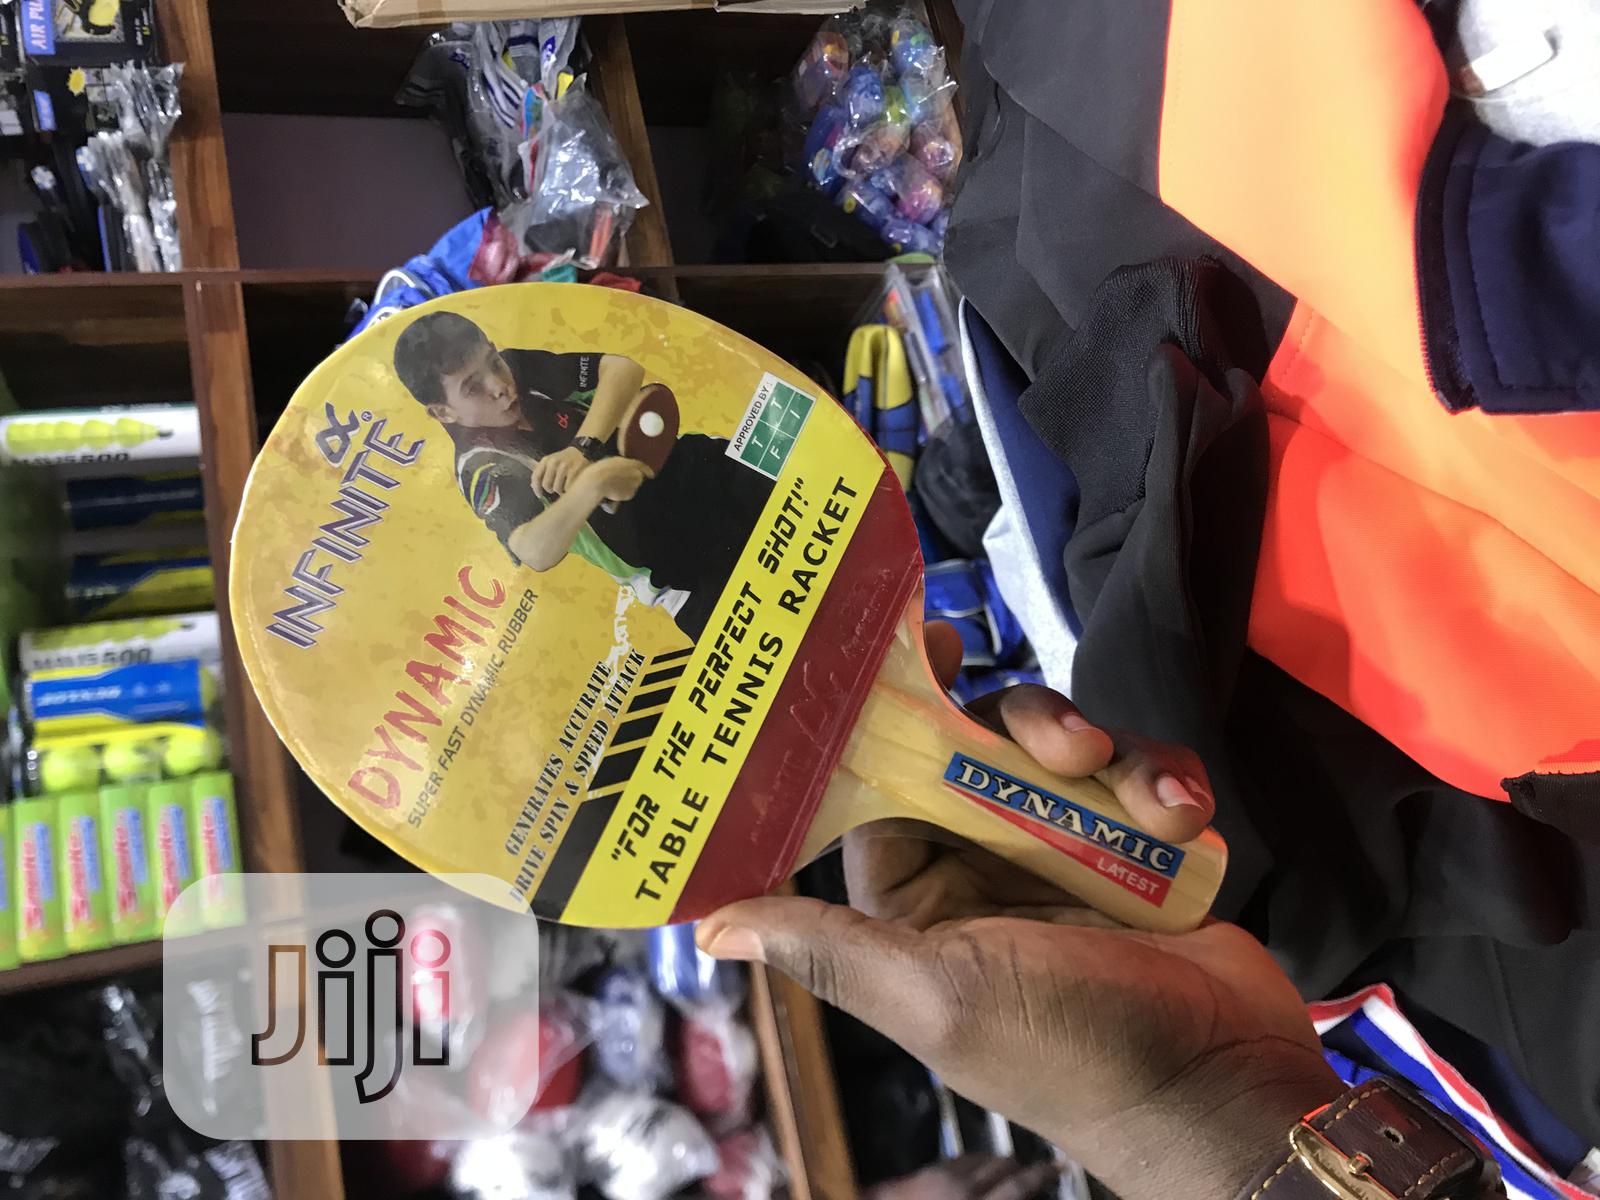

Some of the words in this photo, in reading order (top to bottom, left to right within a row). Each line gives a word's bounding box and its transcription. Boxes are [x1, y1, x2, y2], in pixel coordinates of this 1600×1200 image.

[29, 0, 46, 21] PU
[30, 23, 48, 49] AIR
[734, 401, 763, 452] APPROVED
[265, 418, 426, 649] INFINITE
[347, 565, 507, 809] DYNAMIC
[407, 771, 444, 828] SUPER
[438, 726, 467, 771] FAST
[460, 654, 505, 727] DYNAMIC
[497, 588, 538, 656] RUBBER
[504, 753, 564, 857] GENERATES
[558, 660, 612, 753] ACCURATE
[509, 845, 546, 904] DRIVE
[539, 797, 570, 844] SPIN
[564, 779, 580, 797] &
[573, 719, 610, 778] SPEED
[603, 649, 648, 719] ATTACK
[634, 787, 709, 901] TABLE
[702, 632, 784, 766] TENNIS
[778, 476, 857, 615] RACKET
[653, 721, 695, 780] THE
[688, 581, 763, 714] PERFECT
[955, 761, 1175, 872] DYNAMIC
[1097, 856, 1160, 895] LATEST
